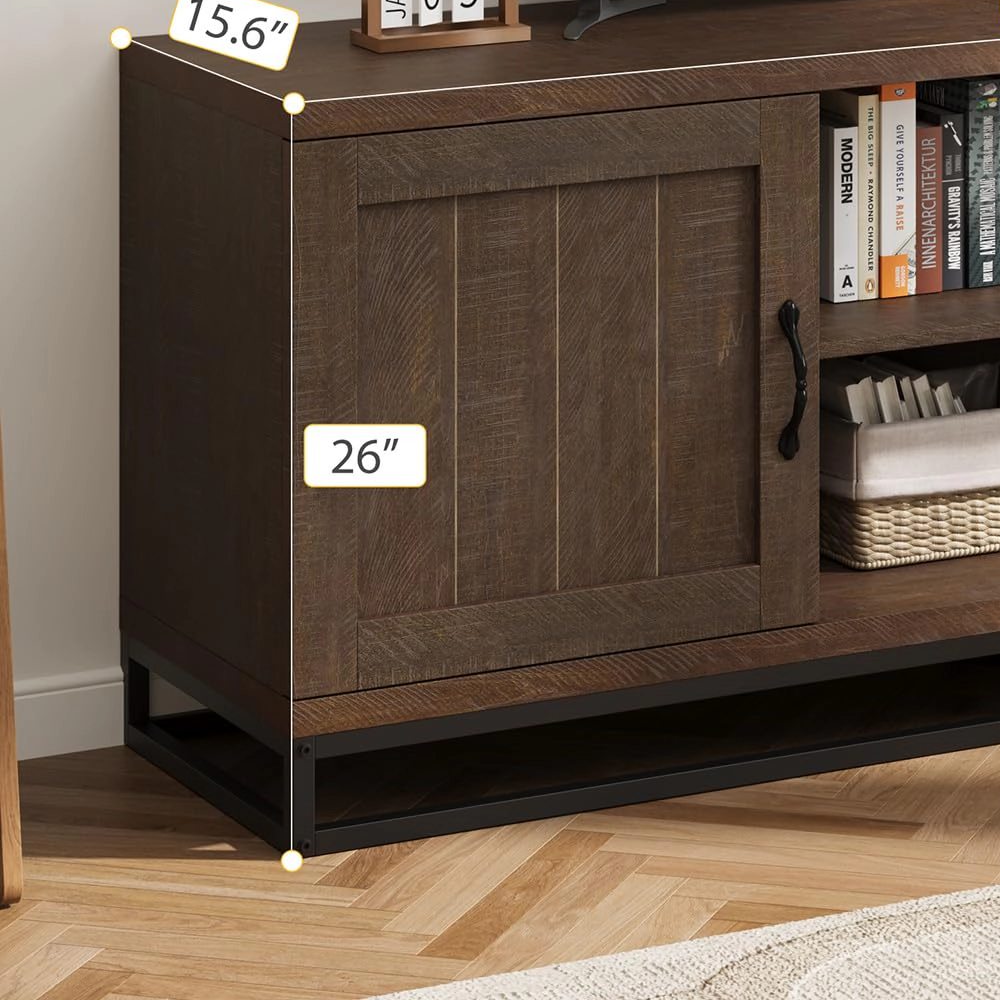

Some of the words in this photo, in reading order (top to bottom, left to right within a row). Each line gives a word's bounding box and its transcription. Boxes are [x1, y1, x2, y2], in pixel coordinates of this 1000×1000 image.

[896, 124, 905, 145] GIVE
[840, 137, 853, 204] MODERN
[896, 147, 905, 193] YOURSELF
[896, 204, 905, 231] RAISE
[921, 137, 937, 270] INNENARCHITEKTUR
[947, 186, 961, 230] GRAVITY'S
[947, 230, 961, 270] RAINBOW
[841, 274, 853, 289] A
